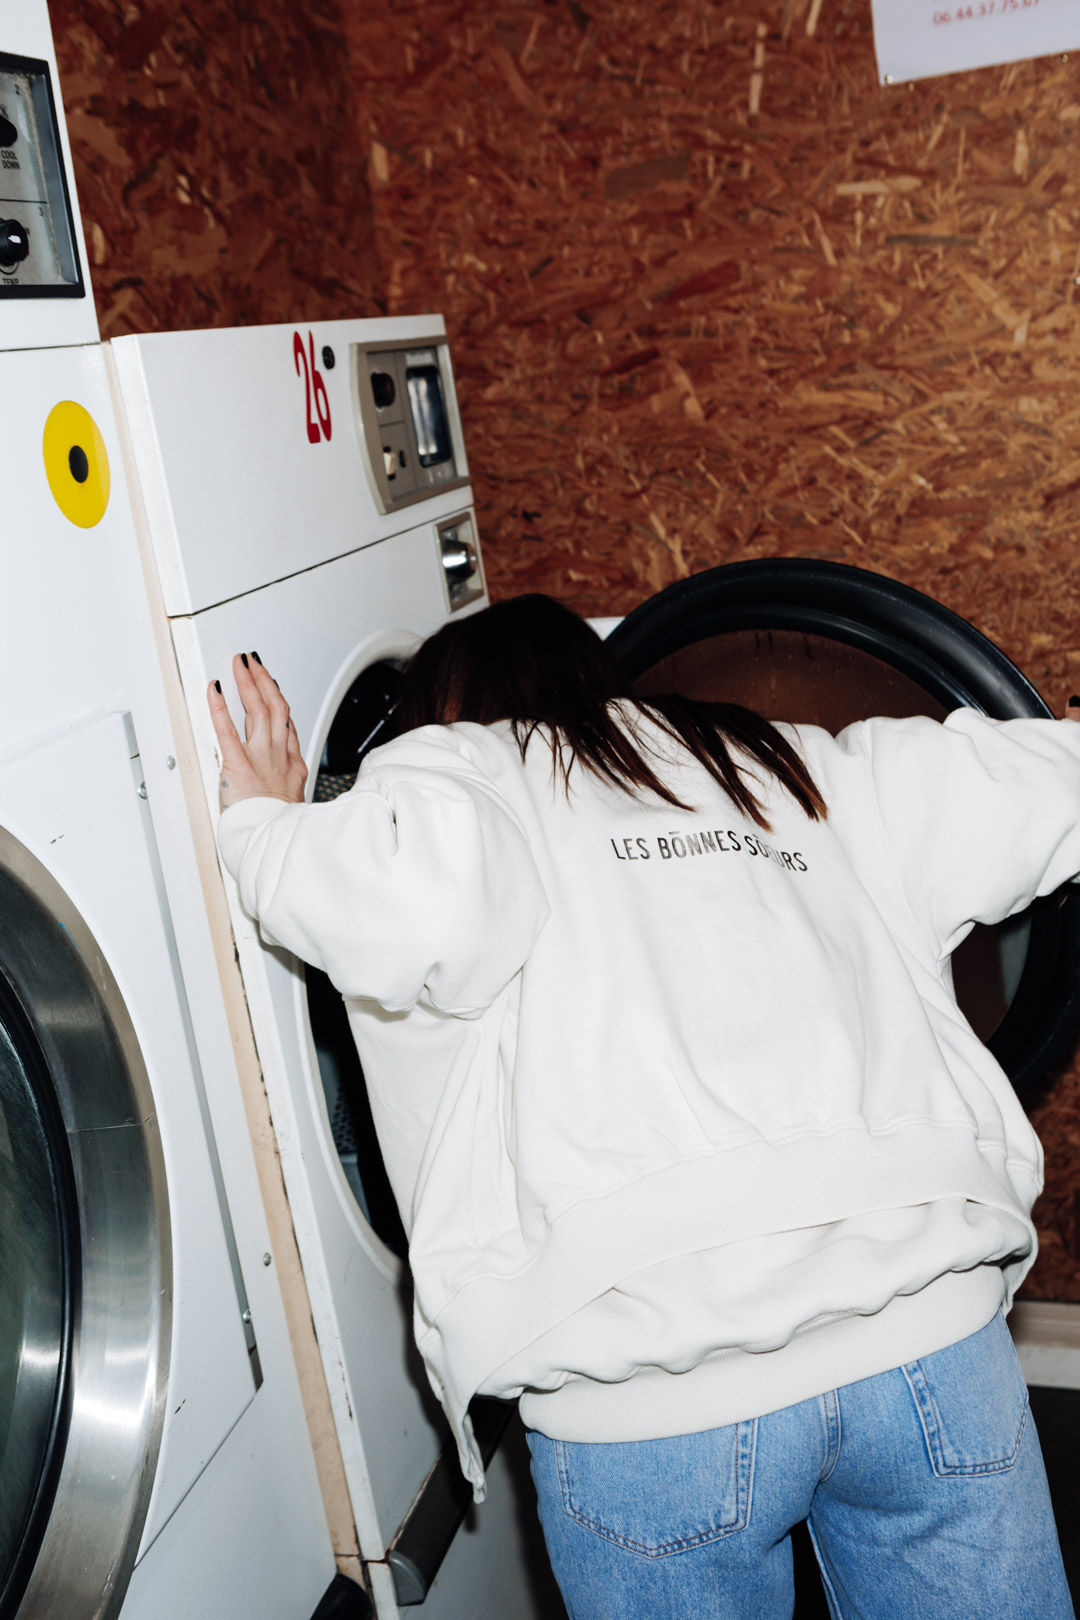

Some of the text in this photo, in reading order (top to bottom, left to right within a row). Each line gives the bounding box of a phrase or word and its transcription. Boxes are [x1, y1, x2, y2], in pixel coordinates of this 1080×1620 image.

[1, 150, 18, 160] COOL
[2, 159, 21, 170] DOWN
[293, 329, 332, 444] 26
[610, 838, 651, 860] LES
